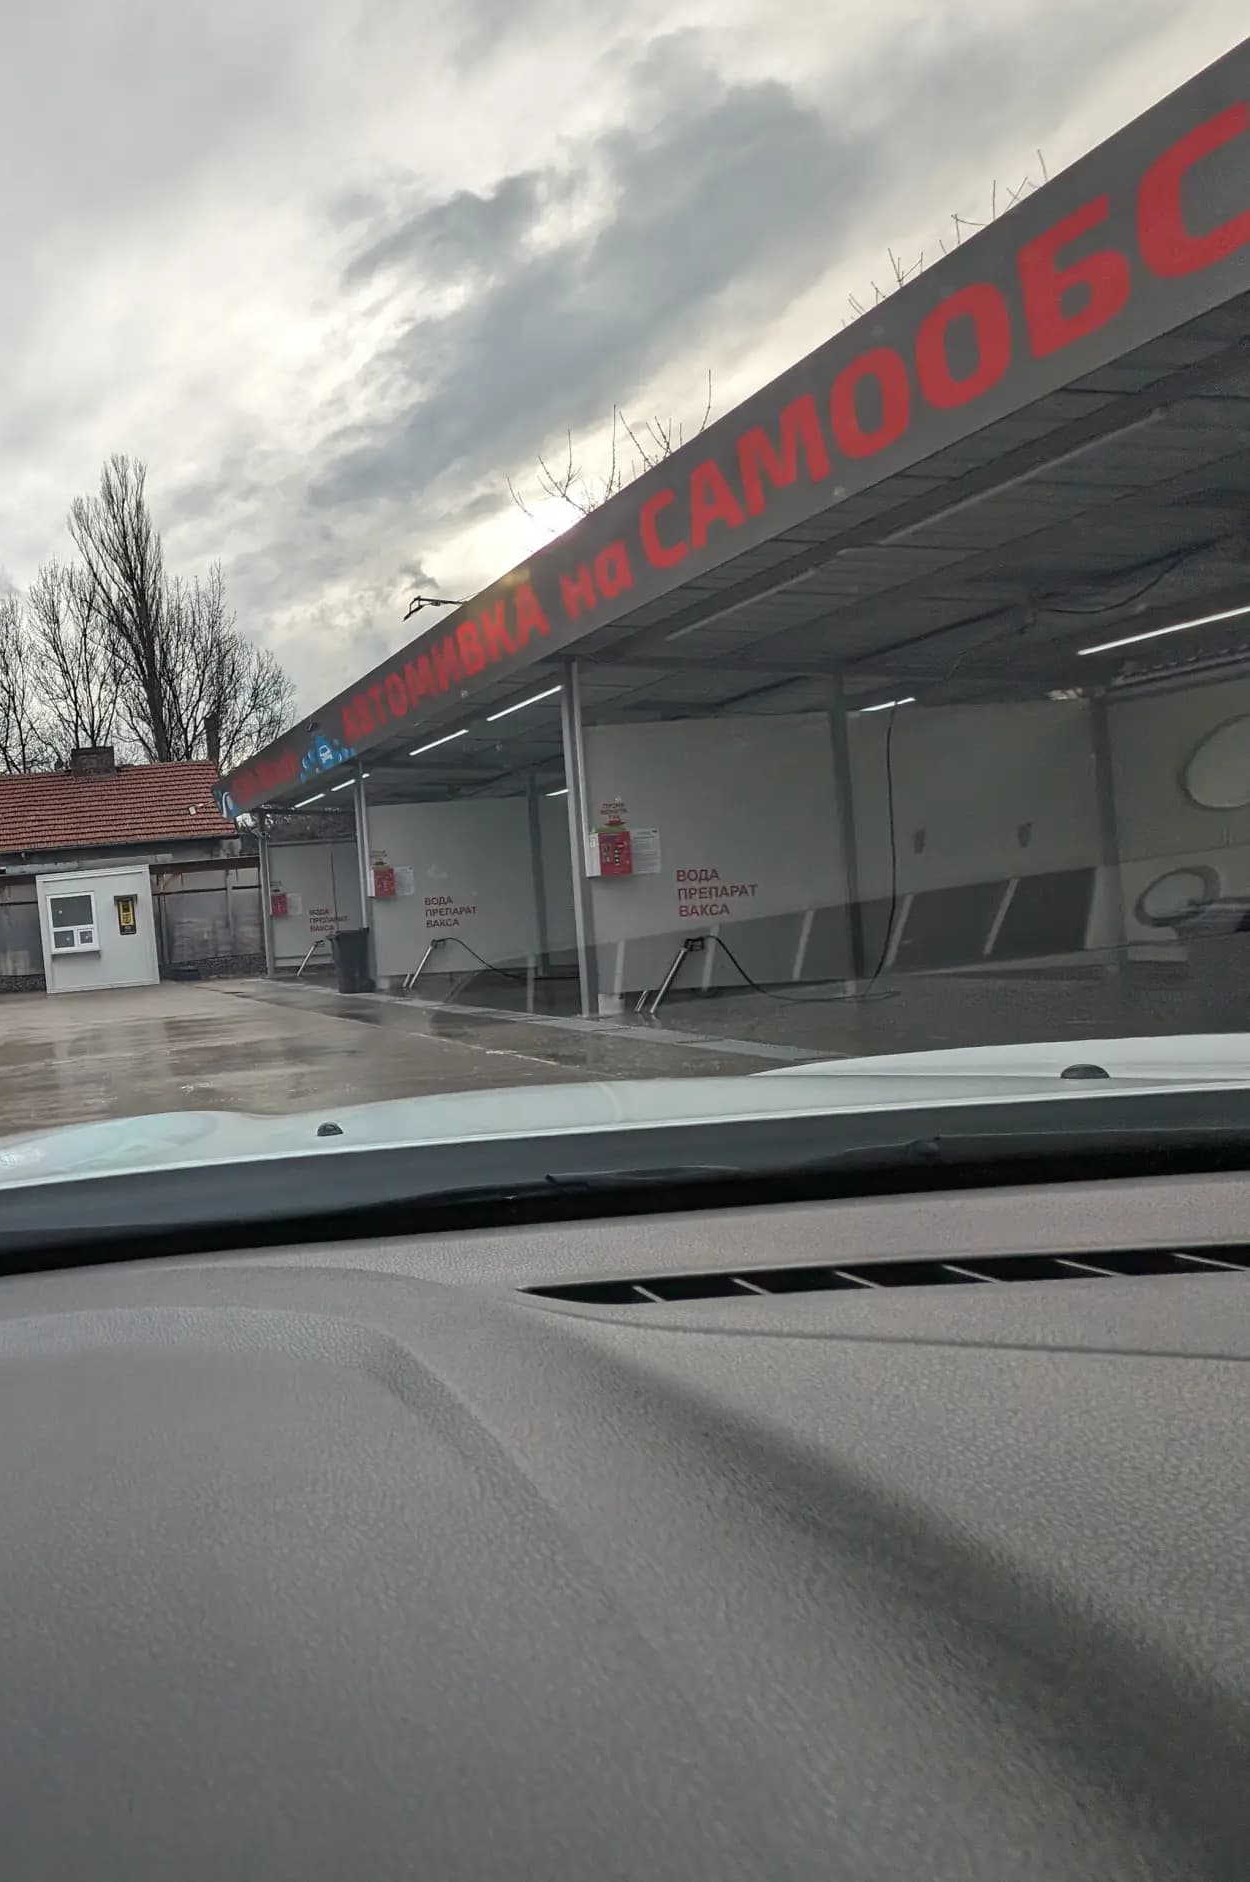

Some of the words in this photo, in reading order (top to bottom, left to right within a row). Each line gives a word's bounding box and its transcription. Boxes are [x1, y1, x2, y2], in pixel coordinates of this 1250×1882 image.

[340, 583, 550, 747] АВТОМИВКА
[559, 543, 634, 621] на
[676, 868, 720, 883] ВОДА
[678, 884, 758, 901] ПРЕПАРАТ
[424, 896, 453, 906] ВОДА
[425, 906, 477, 917] ПРЕПАРАТ
[679, 903, 730, 917] ВАКСА
[426, 918, 460, 928] ВАКСА
